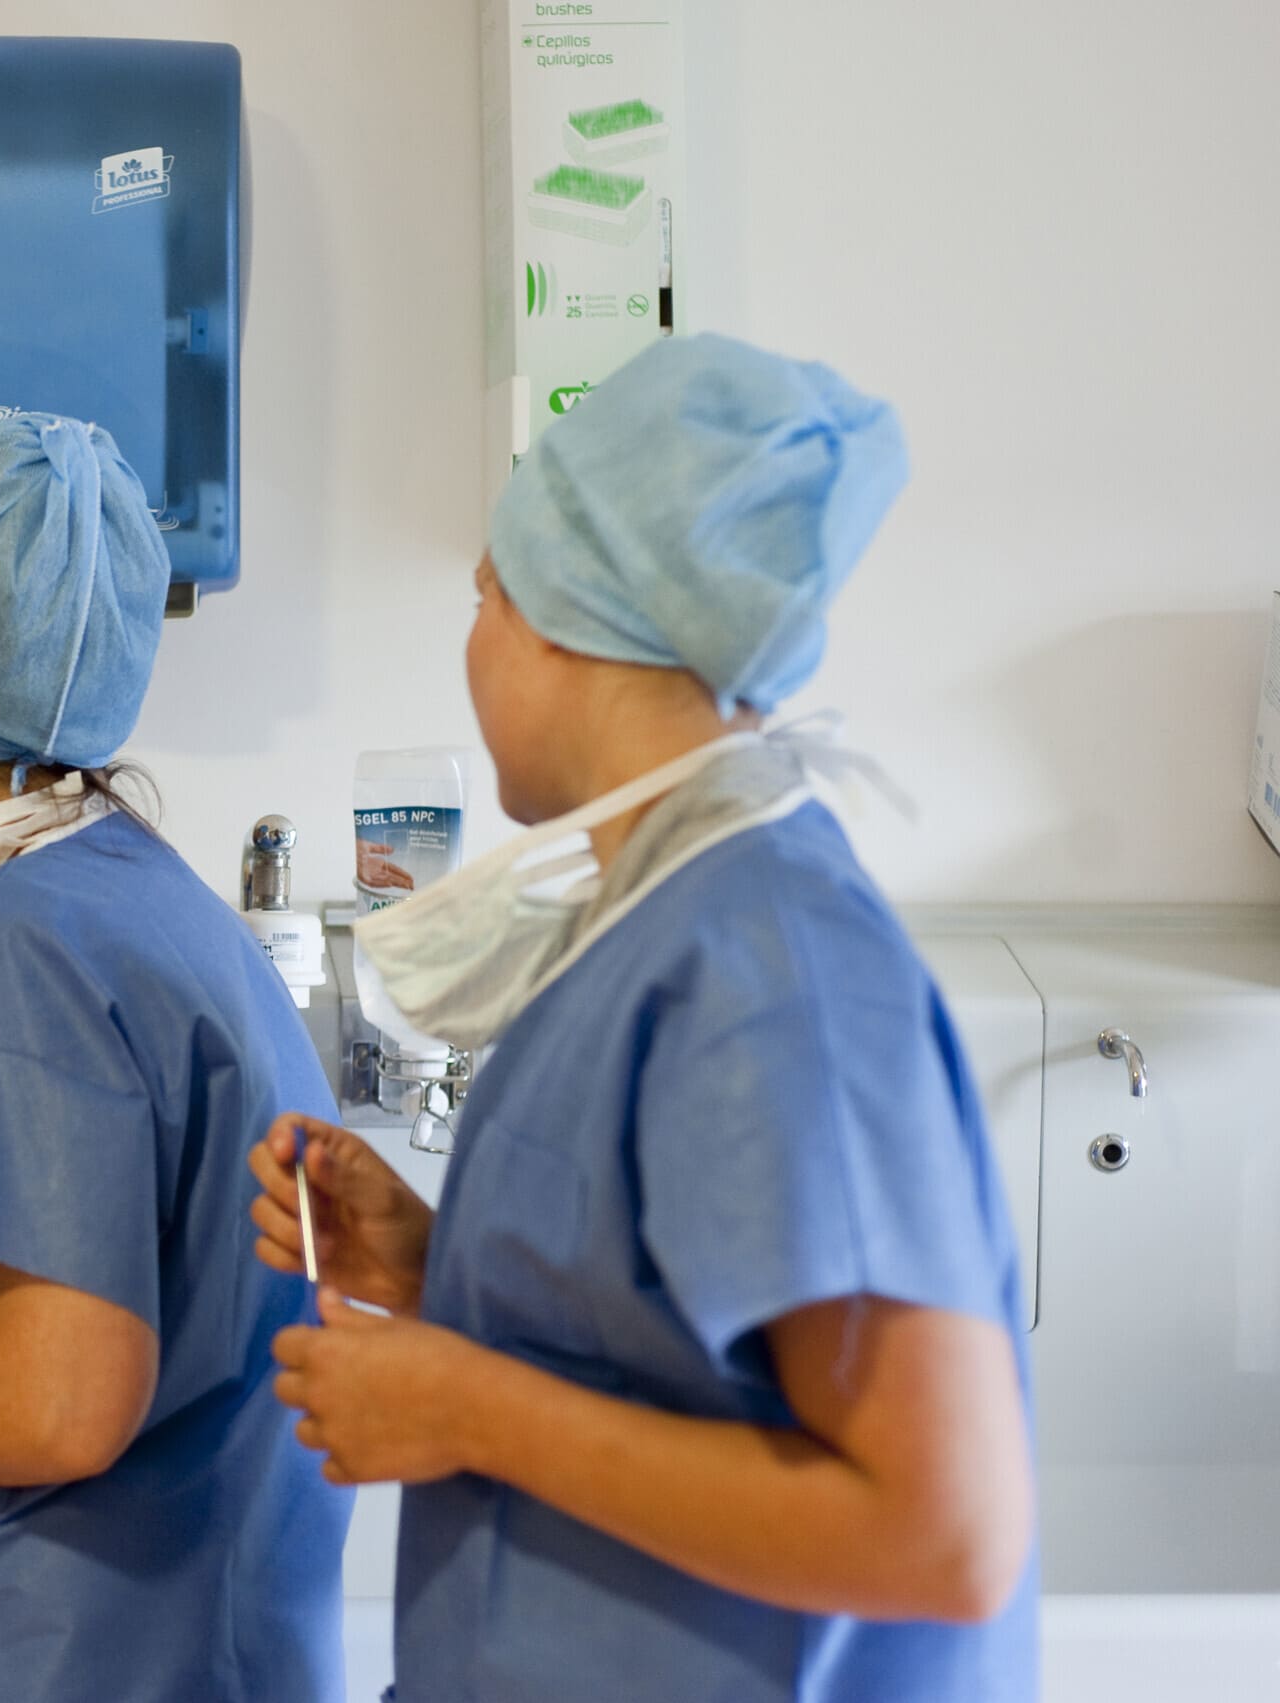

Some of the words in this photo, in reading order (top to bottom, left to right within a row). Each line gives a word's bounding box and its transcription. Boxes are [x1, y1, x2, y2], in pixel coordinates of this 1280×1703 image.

[536, 3, 593, 16] brushes
[536, 35, 592, 50] Cepillos
[536, 51, 614, 68] quirúrgicos
[108, 169, 158, 188] lotus
[566, 306, 582, 318] 25
[355, 812, 388, 826] SGEL
[391, 811, 407, 823] 85
[411, 811, 436, 823] NPC
